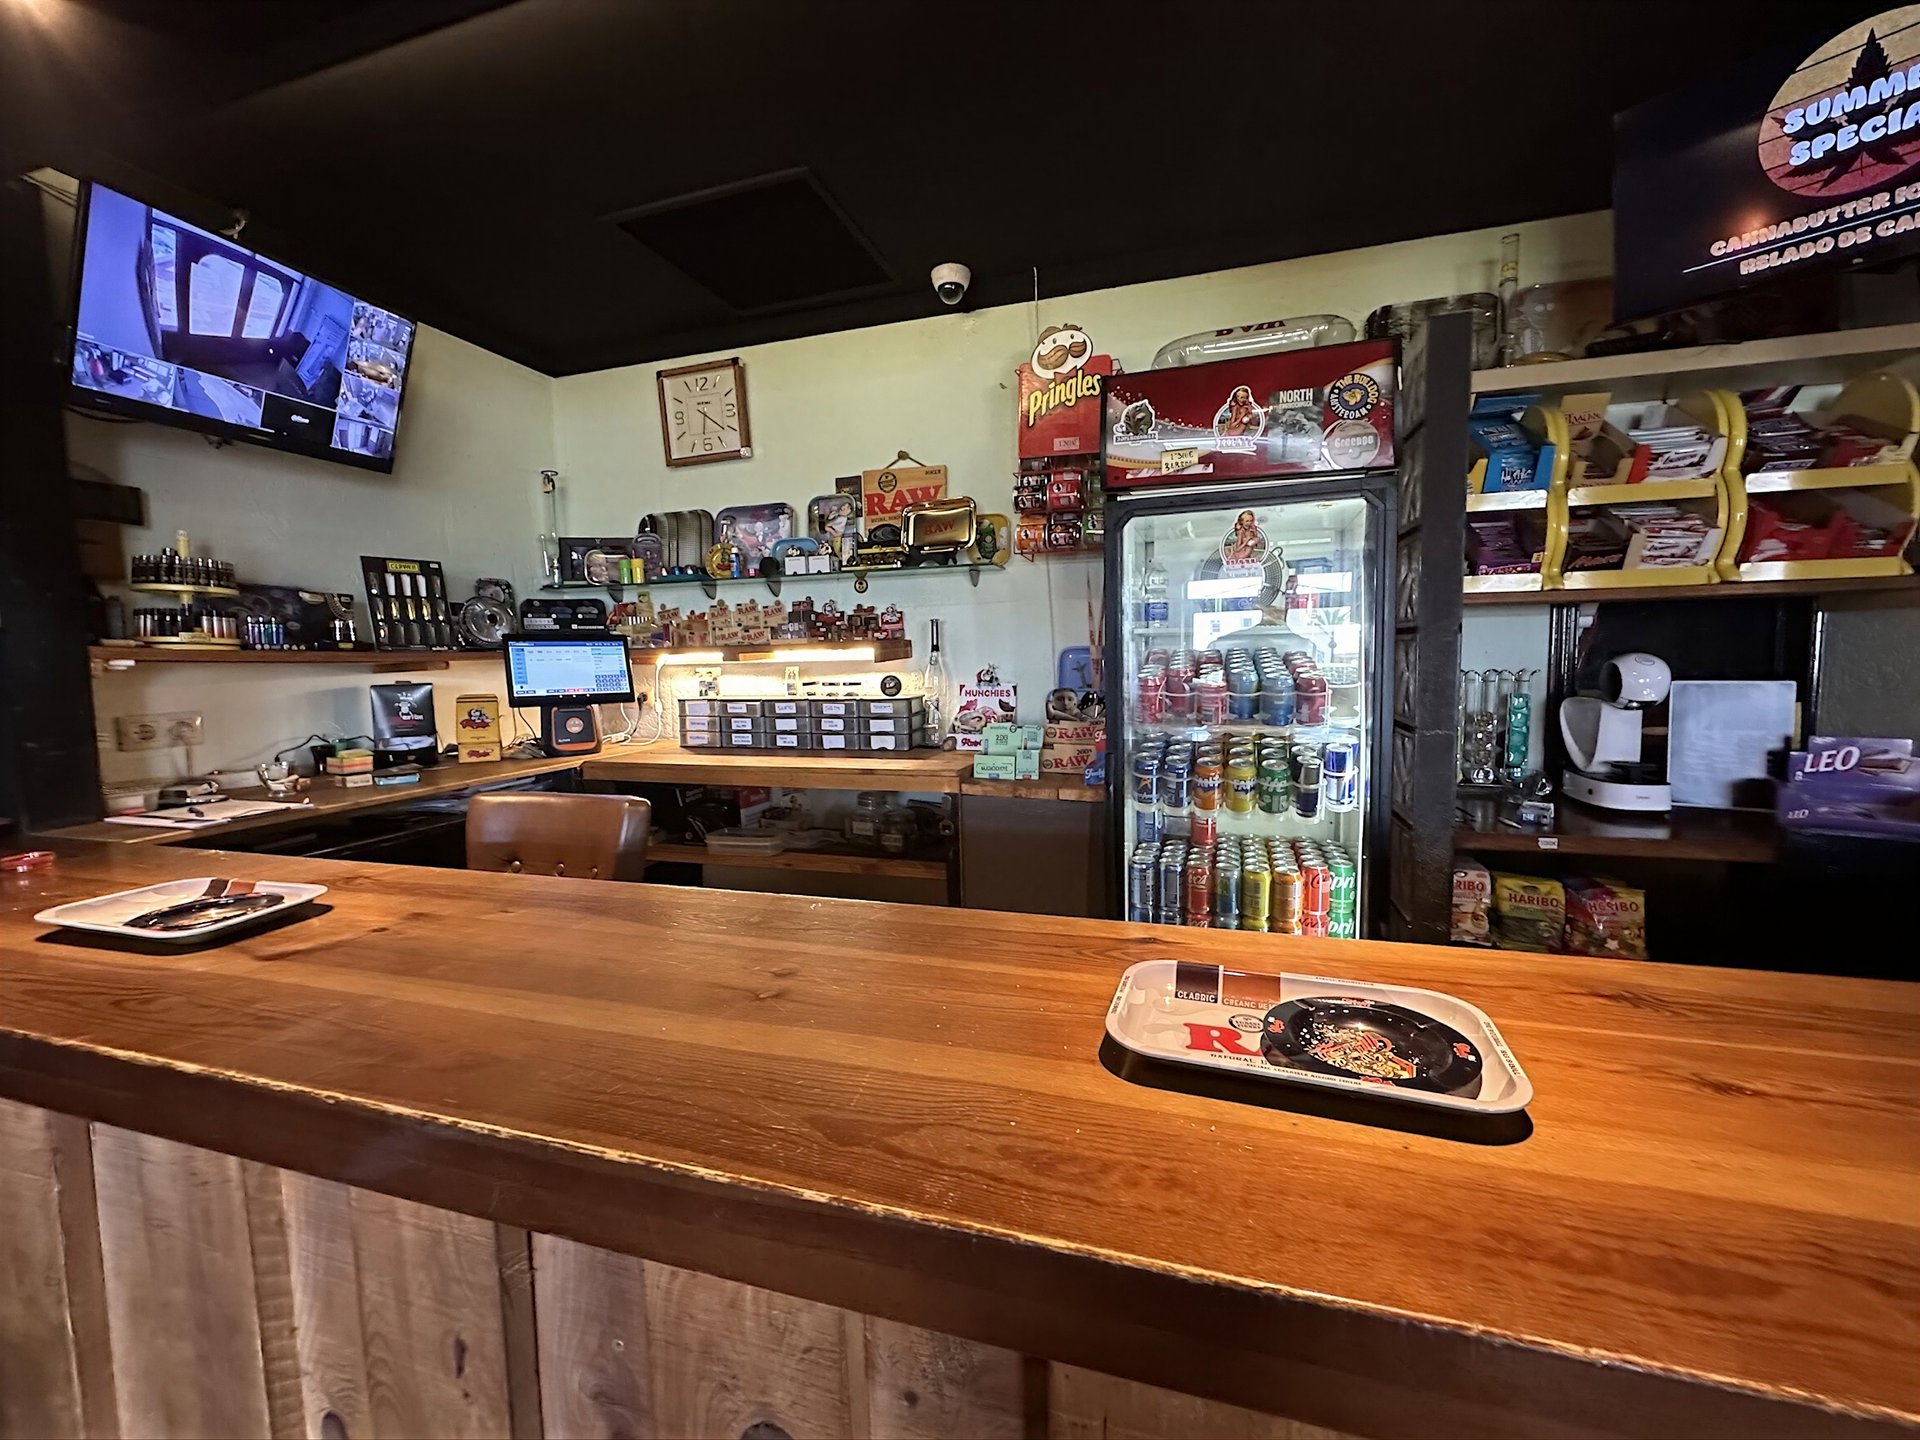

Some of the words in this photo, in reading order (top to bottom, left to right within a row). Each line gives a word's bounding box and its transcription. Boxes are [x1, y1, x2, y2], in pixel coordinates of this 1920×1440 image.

[1838, 226, 1872, 249] DE
[696, 377, 709, 392] 12
[1335, 374, 1353, 390] THE
[1354, 374, 1379, 405] BULLDOG
[1028, 369, 1101, 427] Pringles
[1280, 388, 1313, 403] NORTH
[725, 403, 735, 418] 3
[1330, 393, 1369, 419] AMSTERDAM
[675, 411, 685, 425] 9
[703, 438, 713, 452] 6
[863, 485, 943, 517] RAW
[924, 519, 955, 536] RAW
[964, 688, 1012, 698] MUNCHIES
[1057, 726, 1097, 740] RAW
[1053, 755, 1091, 769] RAW
[1804, 746, 1861, 773] LEO
[1787, 808, 1810, 819] LEO
[1508, 892, 1560, 908] HARIBO
